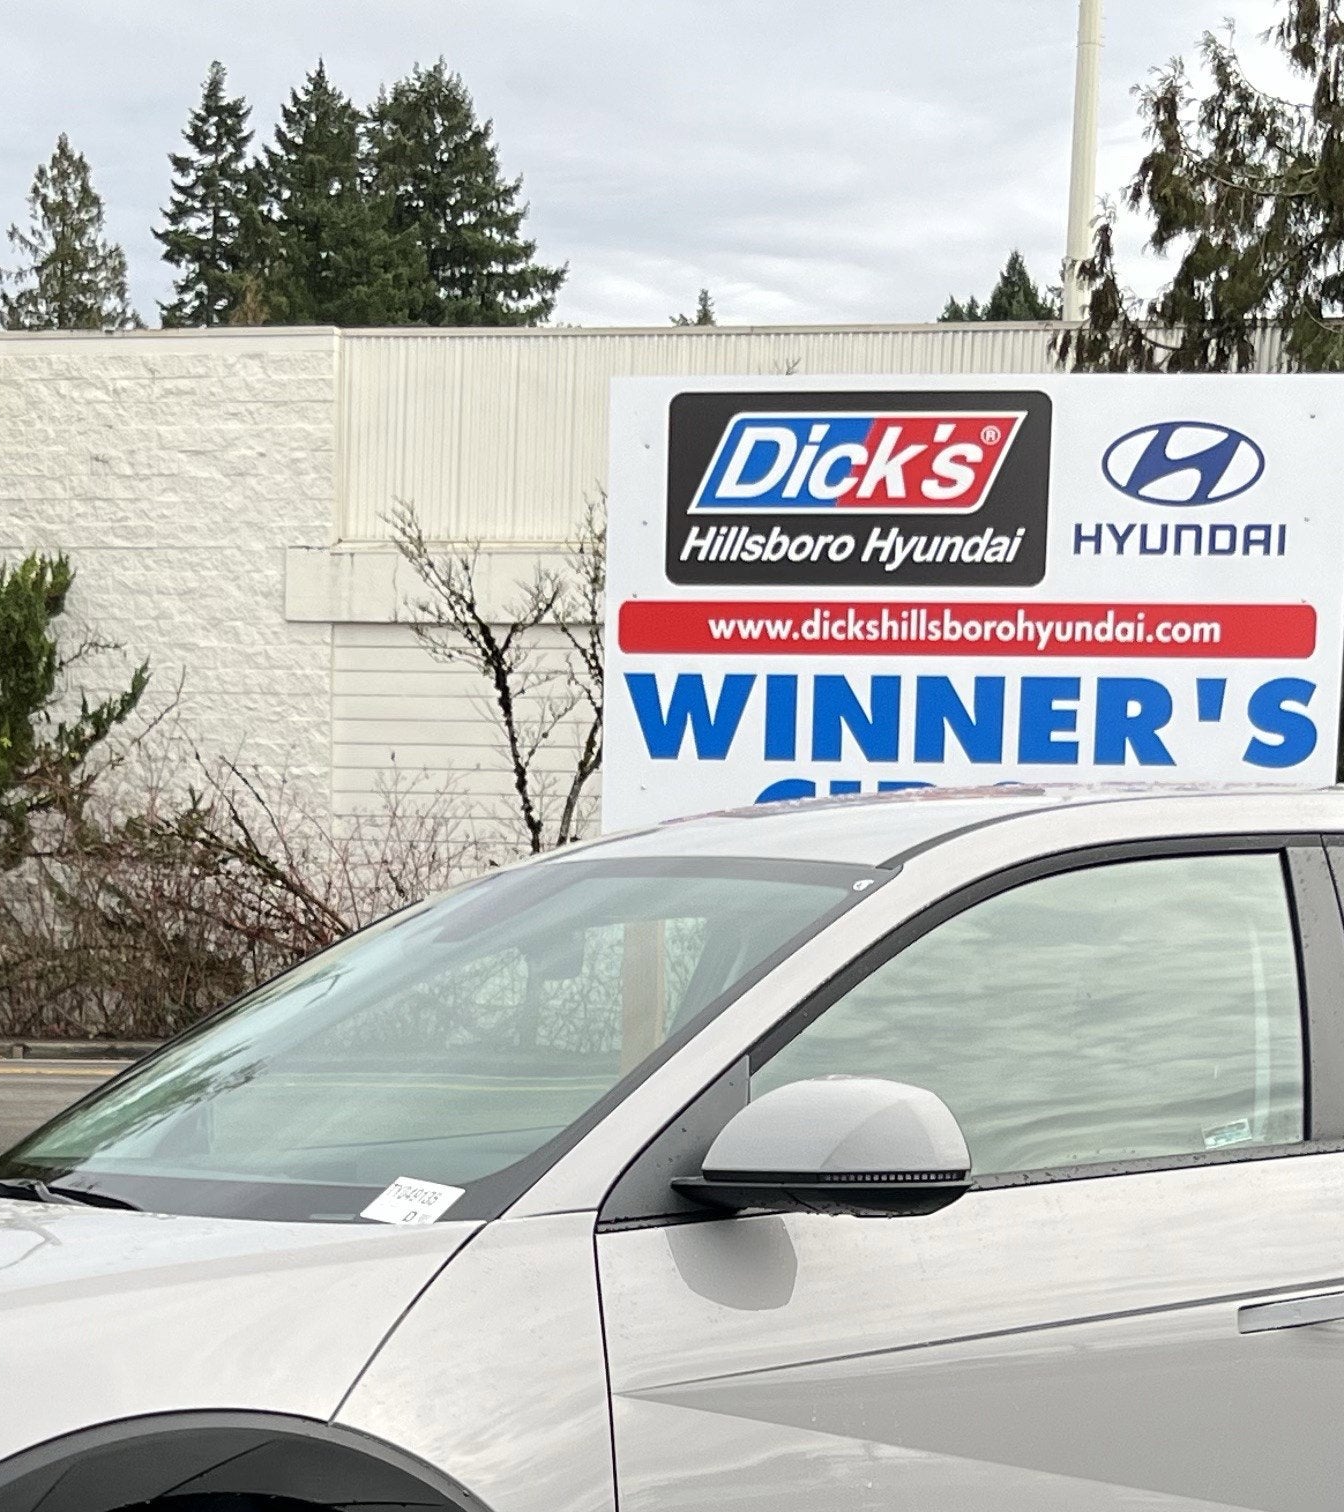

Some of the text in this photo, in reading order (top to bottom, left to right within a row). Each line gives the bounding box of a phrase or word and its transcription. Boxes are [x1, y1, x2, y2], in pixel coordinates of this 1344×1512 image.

[714, 423, 984, 500] Dick's
[678, 526, 1027, 572] Hillsboro Hyundai
[1072, 522, 1288, 557] HYUNDAI
[707, 607, 1222, 648] www.dickshillsborohyundai.com
[623, 672, 1320, 767] WINNER'S
